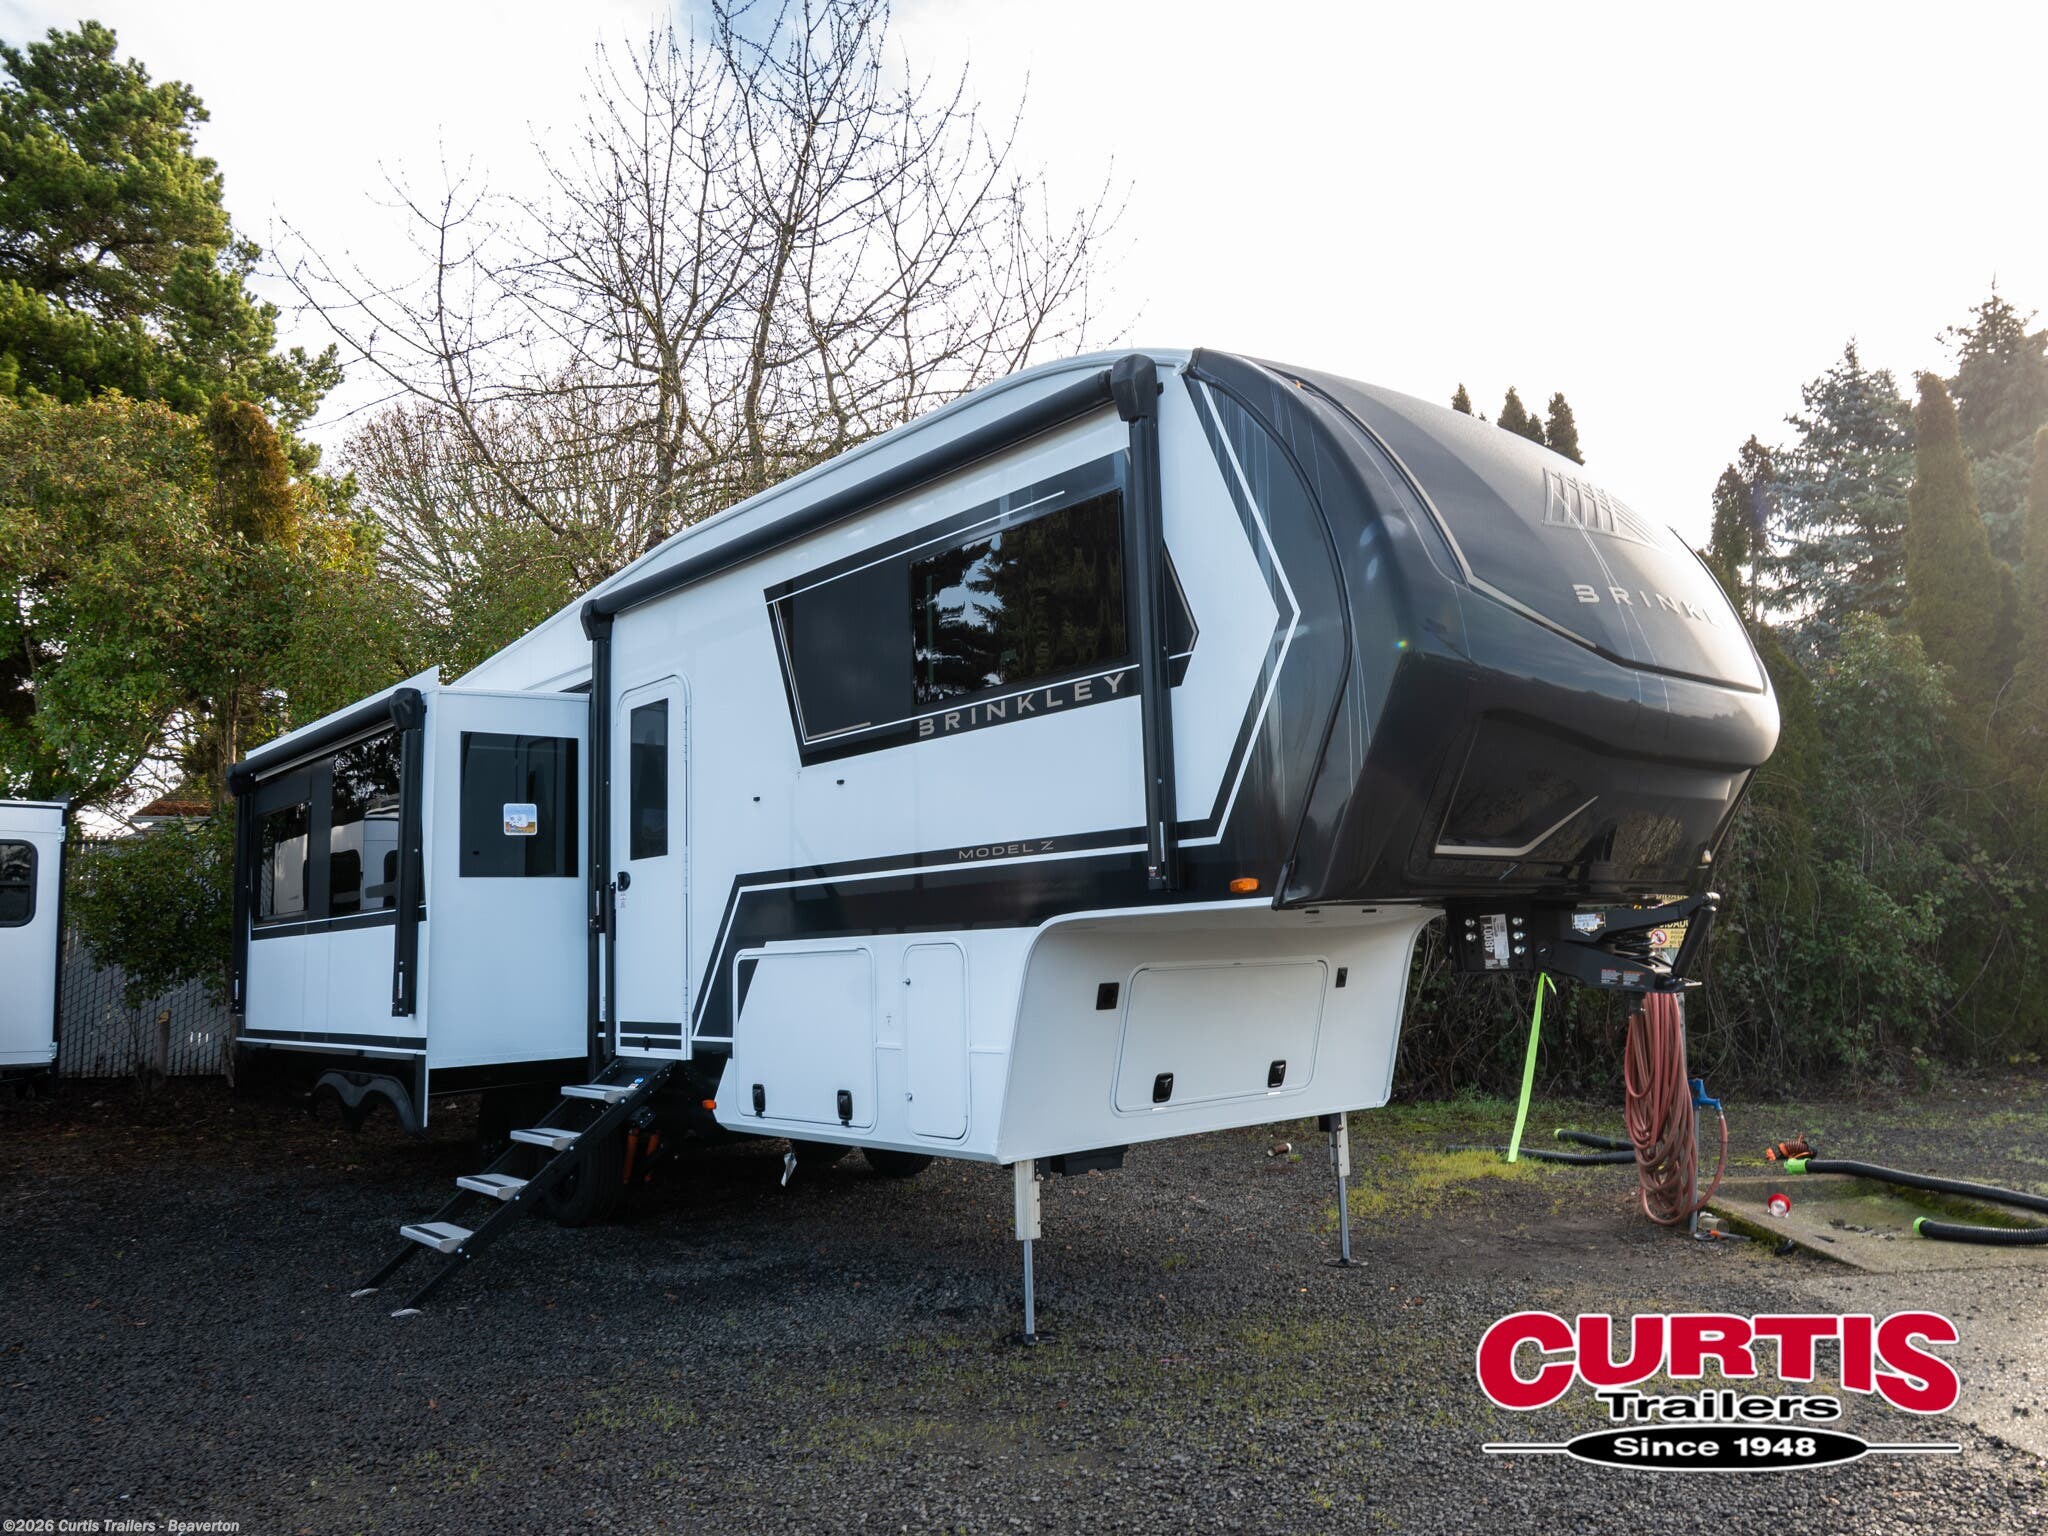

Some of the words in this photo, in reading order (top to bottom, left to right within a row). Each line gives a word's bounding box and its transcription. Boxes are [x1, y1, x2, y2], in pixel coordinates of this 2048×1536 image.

[919, 672, 1126, 738] BRINKLEY
[958, 843, 1035, 860] MODEL
[1040, 840, 1055, 851] Z
